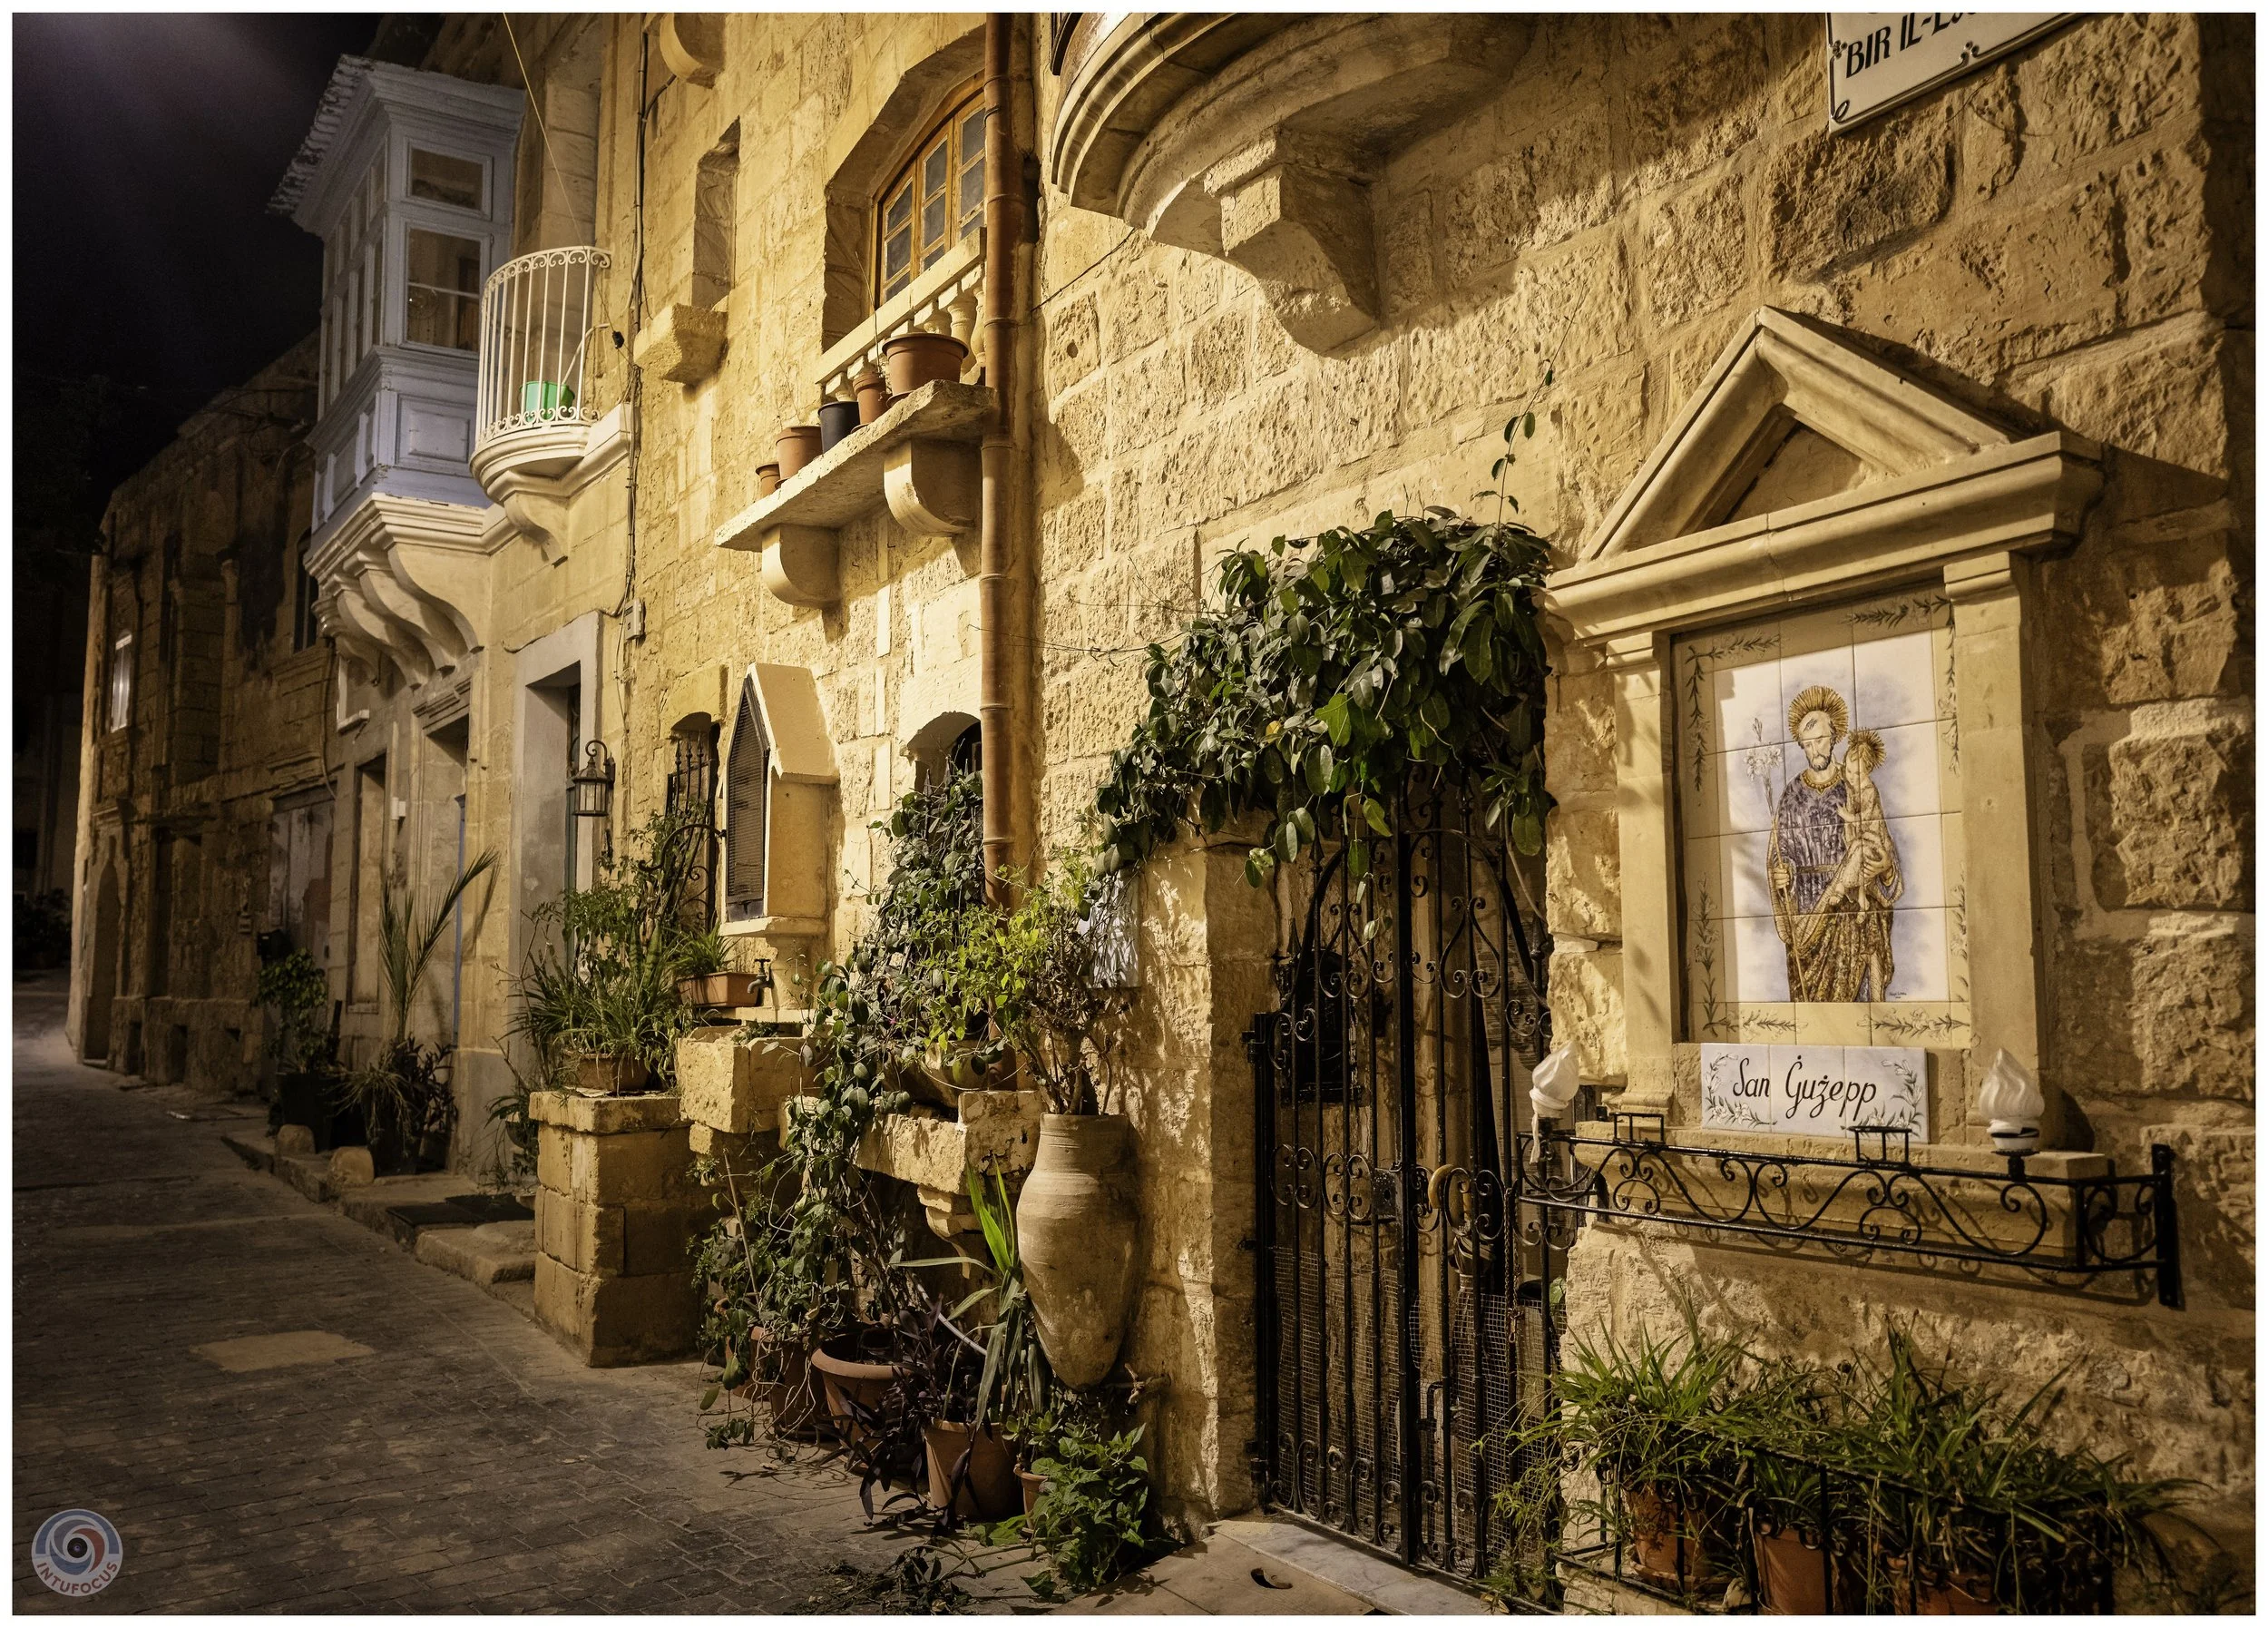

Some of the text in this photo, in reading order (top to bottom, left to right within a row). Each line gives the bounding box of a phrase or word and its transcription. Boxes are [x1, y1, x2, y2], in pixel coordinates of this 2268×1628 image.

[1846, 26, 1891, 79] BIR
[1732, 1054, 1877, 1122] San Ġużepp
